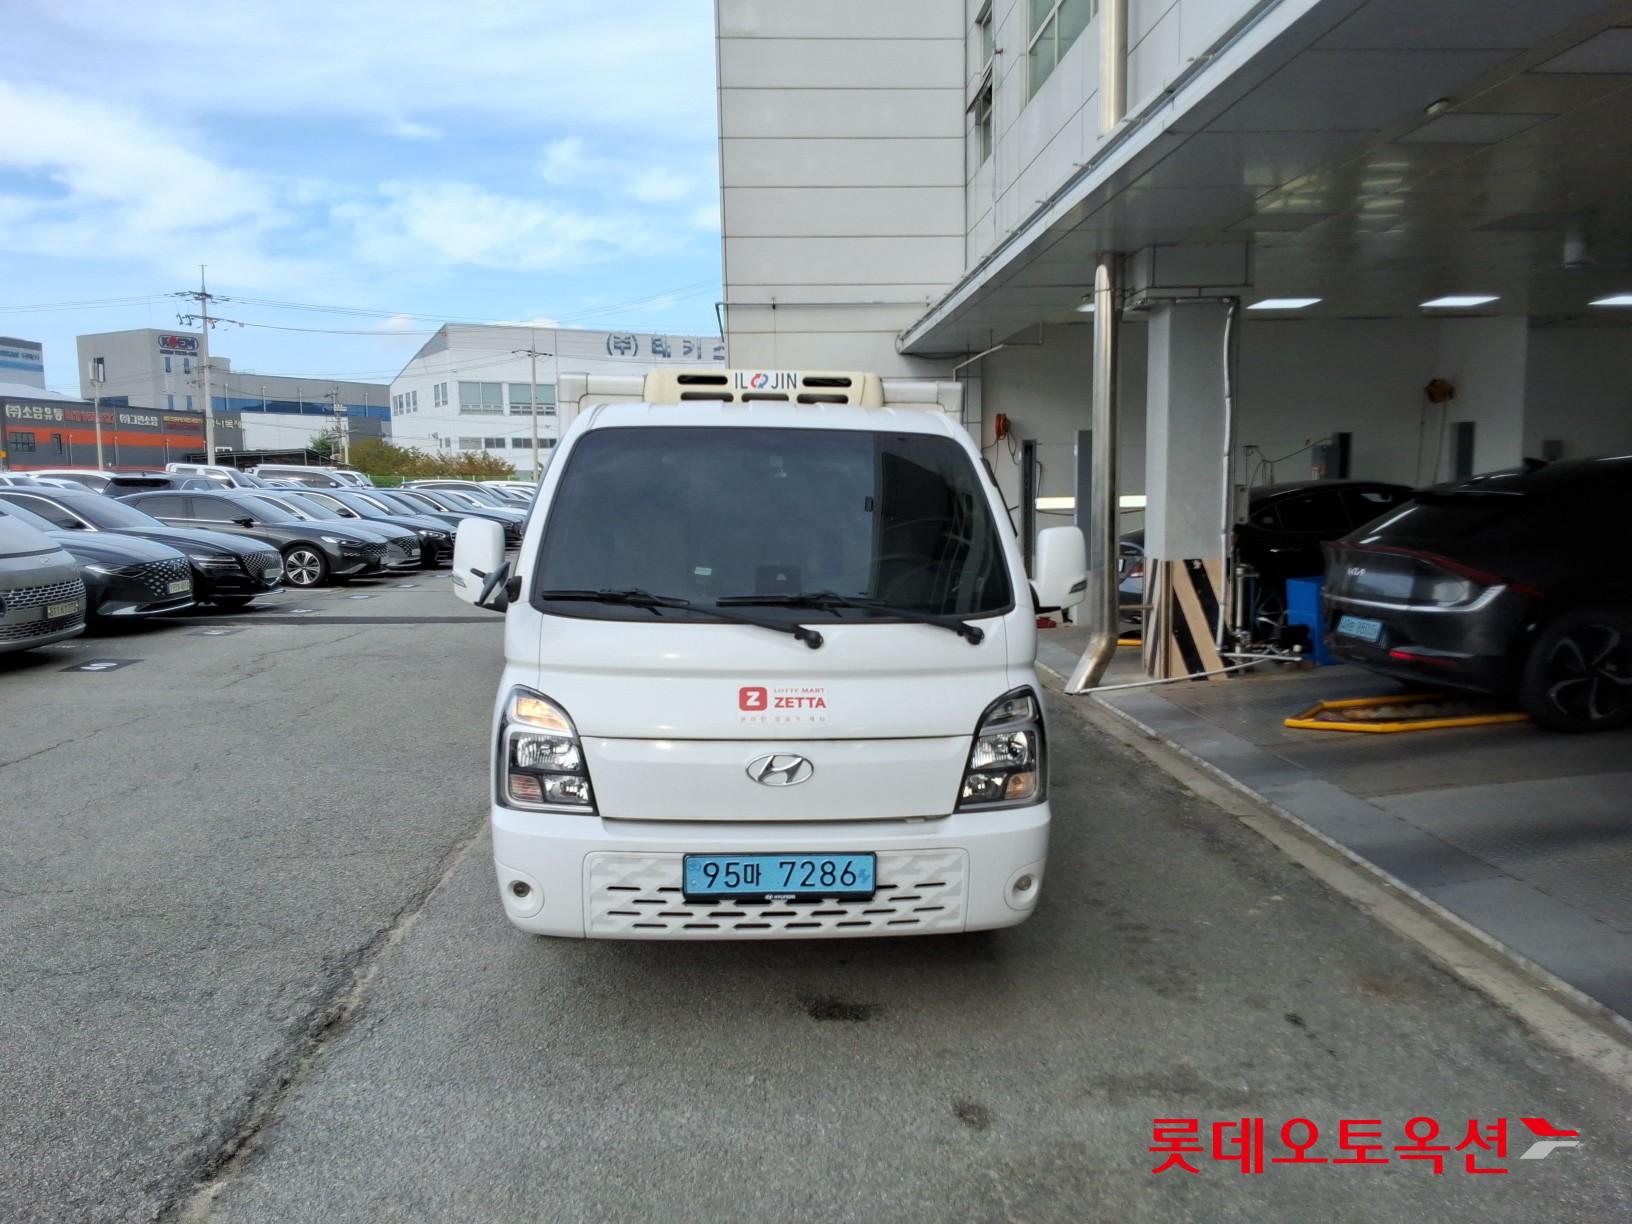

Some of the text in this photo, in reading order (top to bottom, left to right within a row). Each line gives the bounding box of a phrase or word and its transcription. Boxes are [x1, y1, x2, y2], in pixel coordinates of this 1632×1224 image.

[774, 697, 827, 709] ZETTA
[703, 860, 857, 888] 95마 7286
